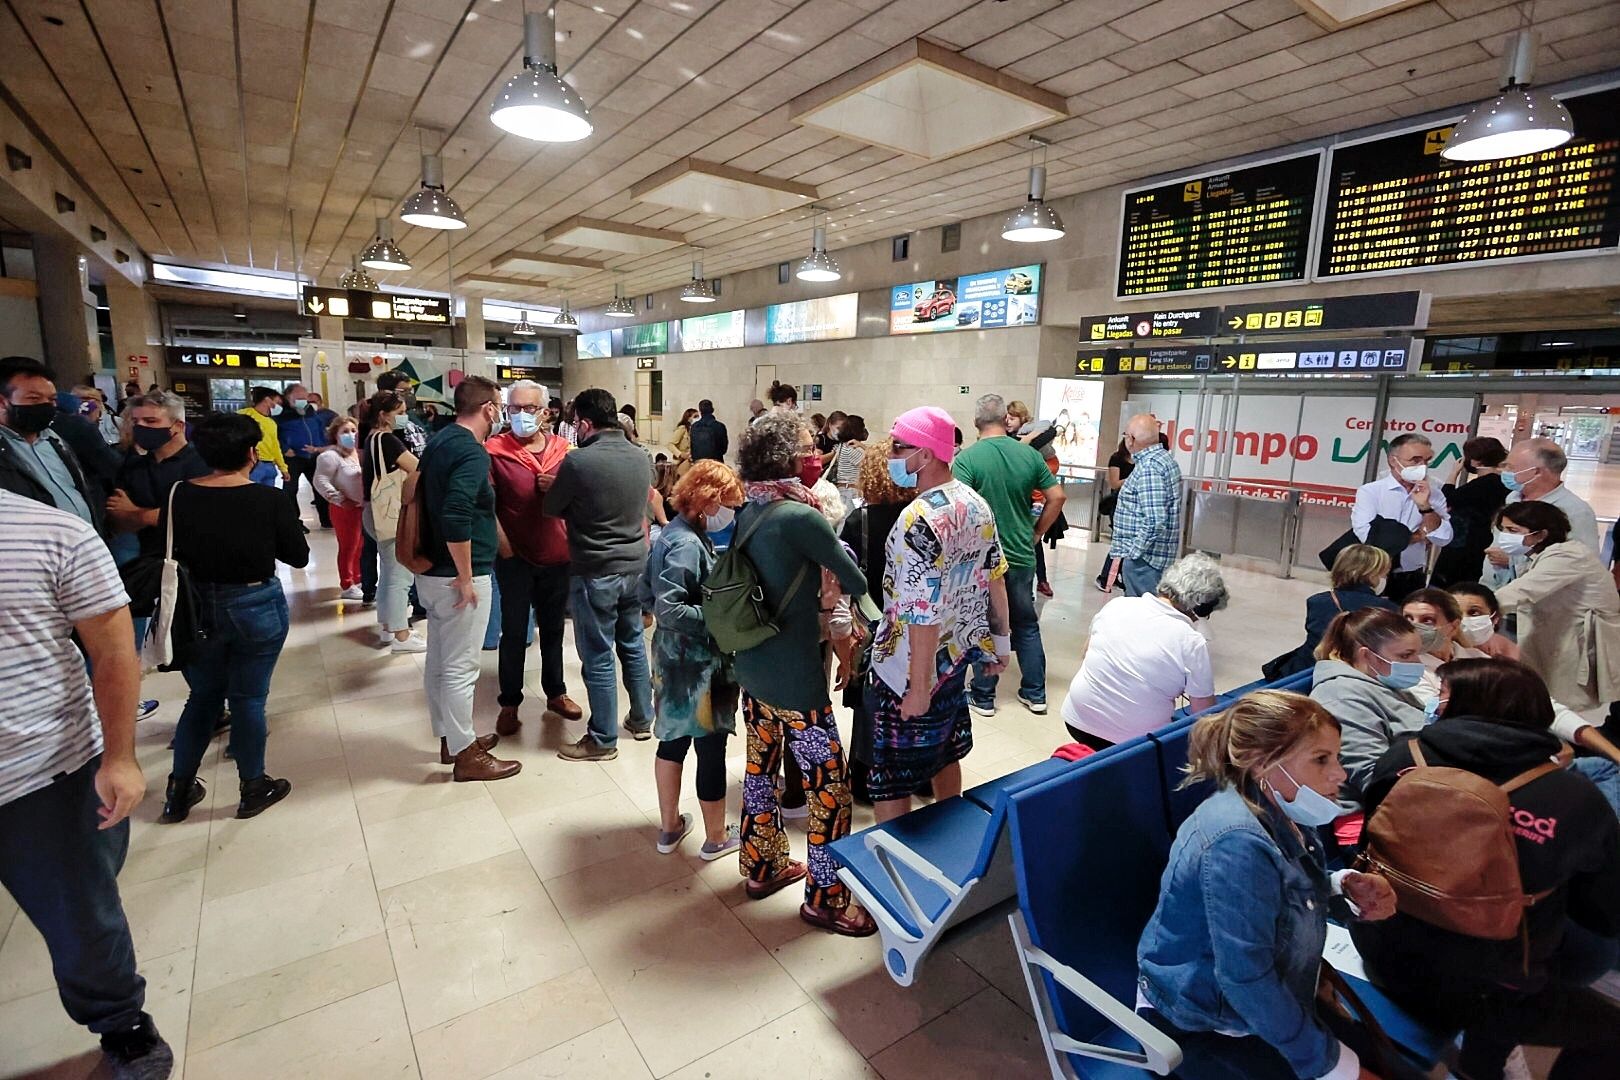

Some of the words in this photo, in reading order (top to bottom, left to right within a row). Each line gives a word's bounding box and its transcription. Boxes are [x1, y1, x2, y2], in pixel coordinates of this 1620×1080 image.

[1339, 198, 1365, 208] 18:35
[1371, 191, 1405, 202] MADRID
[1437, 183, 1449, 192] LA
[1462, 177, 1489, 187] 7049
[1497, 170, 1531, 182] 18:20
[1539, 165, 1553, 175] ON
[1562, 159, 1592, 171] TIME
[1340, 186, 1367, 196] 18:35
[1373, 179, 1407, 190] MADRID
[1499, 156, 1533, 168] 18:20
[1541, 151, 1556, 160] ON
[1565, 144, 1595, 156] TIME
[1207, 188, 1234, 198] Llegadas
[1337, 209, 1363, 219] 18:35
[1369, 202, 1403, 213] MADRID
[1460, 189, 1486, 199] 3944
[1495, 182, 1529, 194] 18:20
[1537, 178, 1551, 187] ON
[1560, 172, 1590, 183] TIME
[1334, 231, 1360, 241] 18:35
[1366, 226, 1400, 236] MADRID
[1456, 214, 1482, 224] 8780
[1490, 208, 1524, 219] 18:20
[1532, 205, 1546, 214] ON
[1555, 200, 1584, 210] TIME
[1336, 220, 1362, 229] 18:35
[1367, 214, 1402, 225] MADRID
[1492, 195, 1527, 206] 18:20
[1535, 192, 1549, 200] ON
[1557, 186, 1587, 197] TIME
[1331, 254, 1359, 263] 18:50
[1362, 247, 1420, 259] FUERTEVENT
[1459, 240, 1478, 248] 427
[1485, 235, 1520, 245] 18:50
[1527, 232, 1541, 240] ON
[1550, 227, 1579, 237] TIME
[1333, 244, 1359, 253] 18:40
[1461, 228, 1480, 237] 173
[1488, 223, 1522, 233] 18:40
[1330, 265, 1358, 273] 19:00
[1361, 259, 1413, 270] LANZAROTE
[1483, 247, 1517, 257] 19:00
[394, 310, 415, 321] Larga
[1163, 320, 1178, 328] entry
[1168, 311, 1200, 320] Durchgang
[1270, 316, 1277, 325] P
[1107, 330, 1133, 338] Llegadas
[1163, 328, 1182, 336] pasar
[1346, 417, 1416, 432] Centro
[1150, 414, 1318, 464] lcampo
[1510, 806, 1556, 838] od
